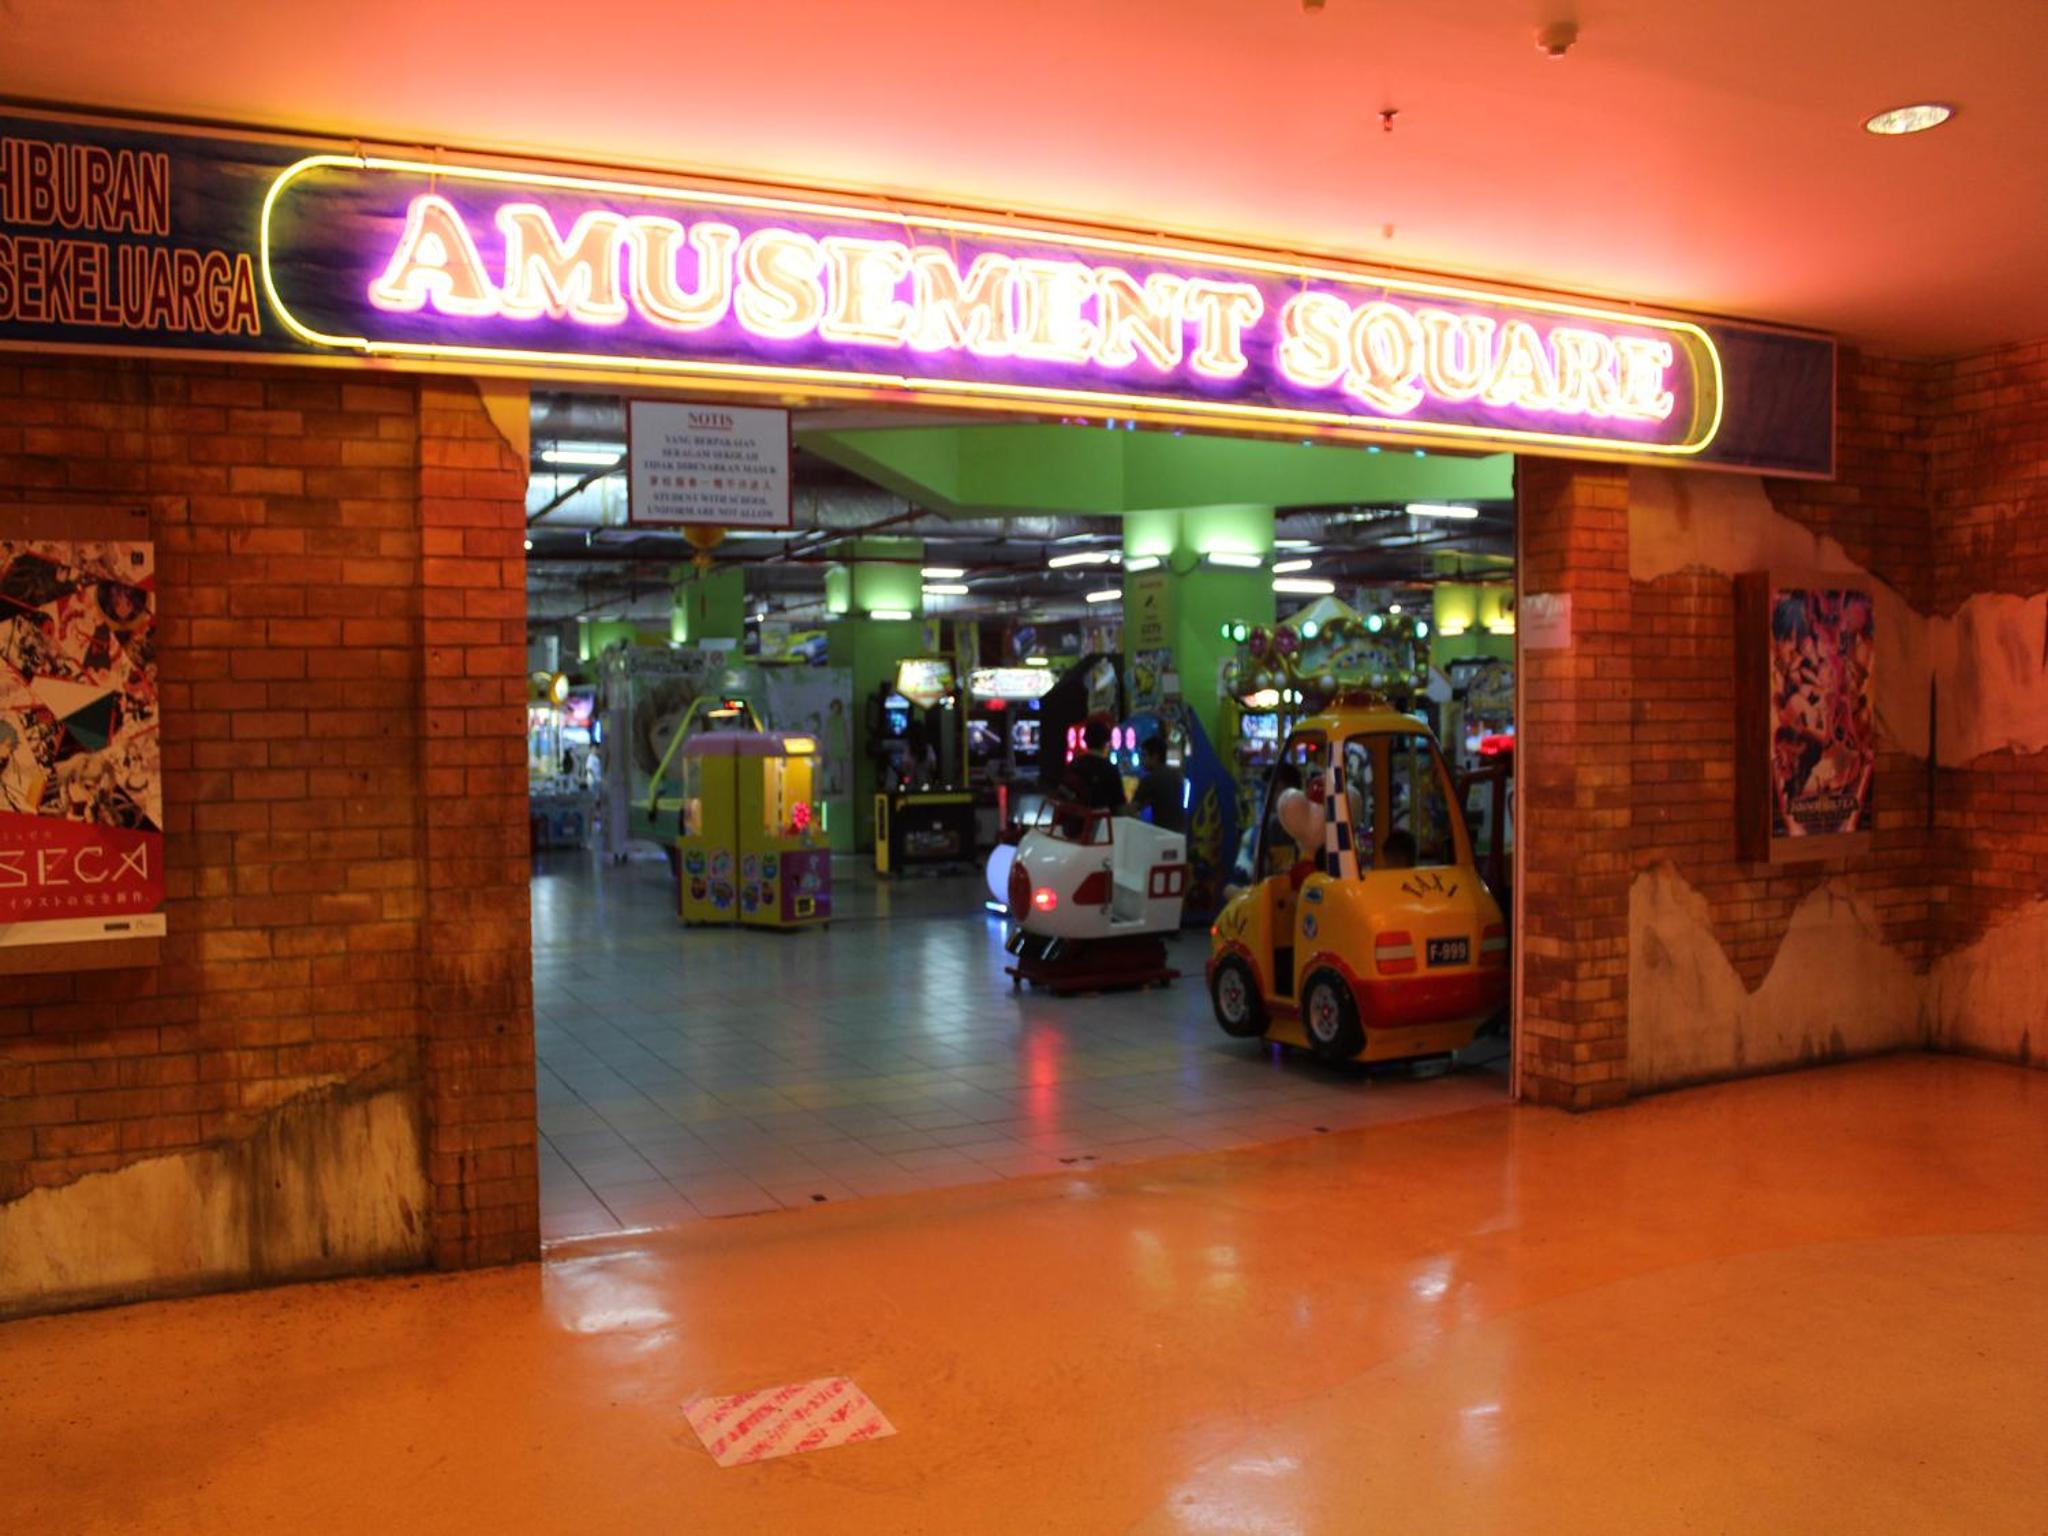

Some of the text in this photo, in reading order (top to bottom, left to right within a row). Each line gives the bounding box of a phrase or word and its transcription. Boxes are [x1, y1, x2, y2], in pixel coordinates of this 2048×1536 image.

[0, 233, 262, 337] SEKELUARGA
[368, 193, 1676, 421] AMUSEMENT SQUARE
[687, 411, 734, 427] NOTIS
[664, 434, 756, 448] YANG BERPAKAIAN
[712, 450, 760, 461] SEKOLAH
[643, 460, 777, 475] TIDAK DIBENARKAN MASUK
[652, 492, 768, 506] STUDENT WITH SCHOOL
[647, 504, 775, 519] UNIFORM ARE NOT ALLOW
[1429, 940, 1467, 962] F-999
